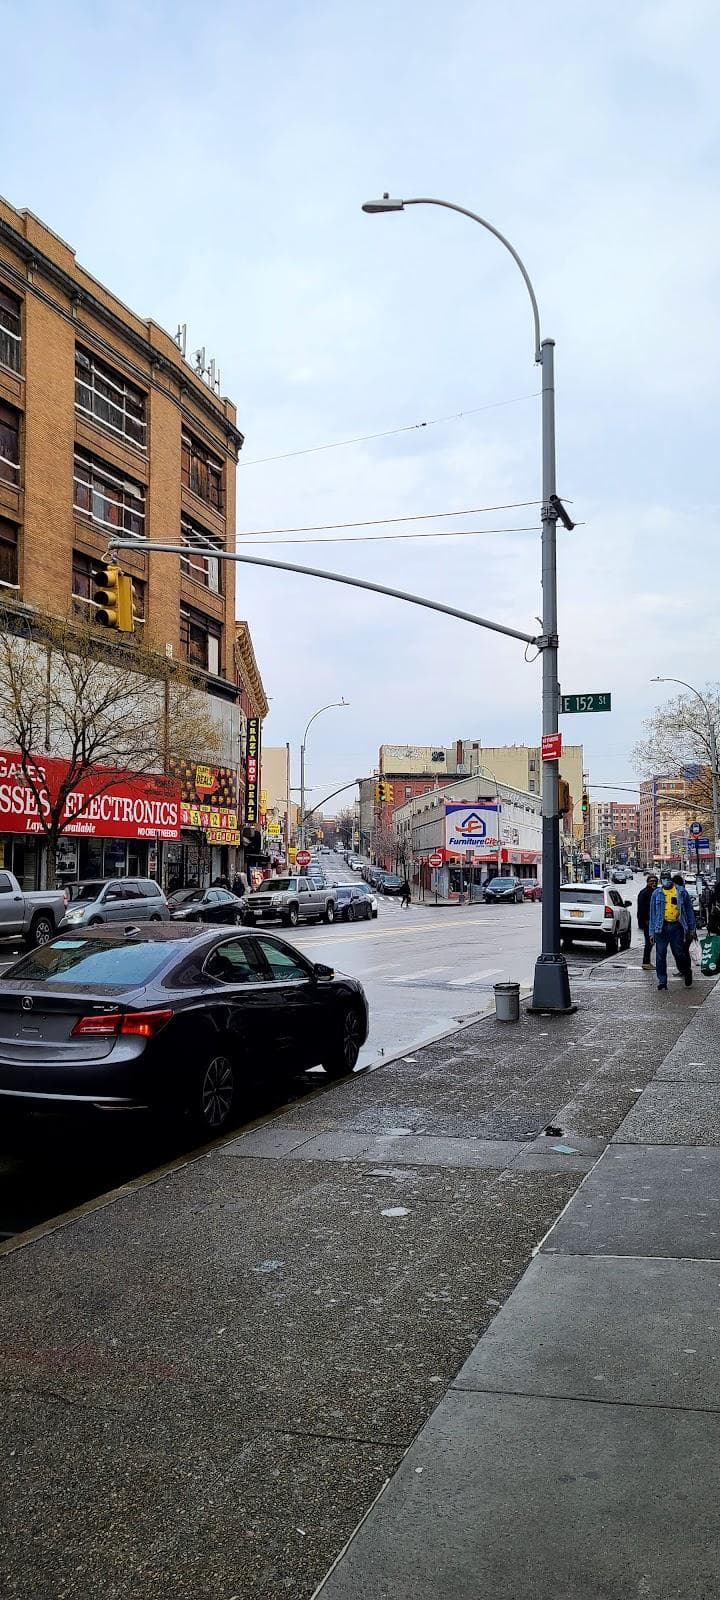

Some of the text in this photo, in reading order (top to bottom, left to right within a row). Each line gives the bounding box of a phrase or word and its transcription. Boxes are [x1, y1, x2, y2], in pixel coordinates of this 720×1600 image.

[564, 695, 606, 711] E 152 St
[247, 720, 257, 821] CRAZY HOT DEALS
[63, 792, 178, 826] ELECTRONICS
